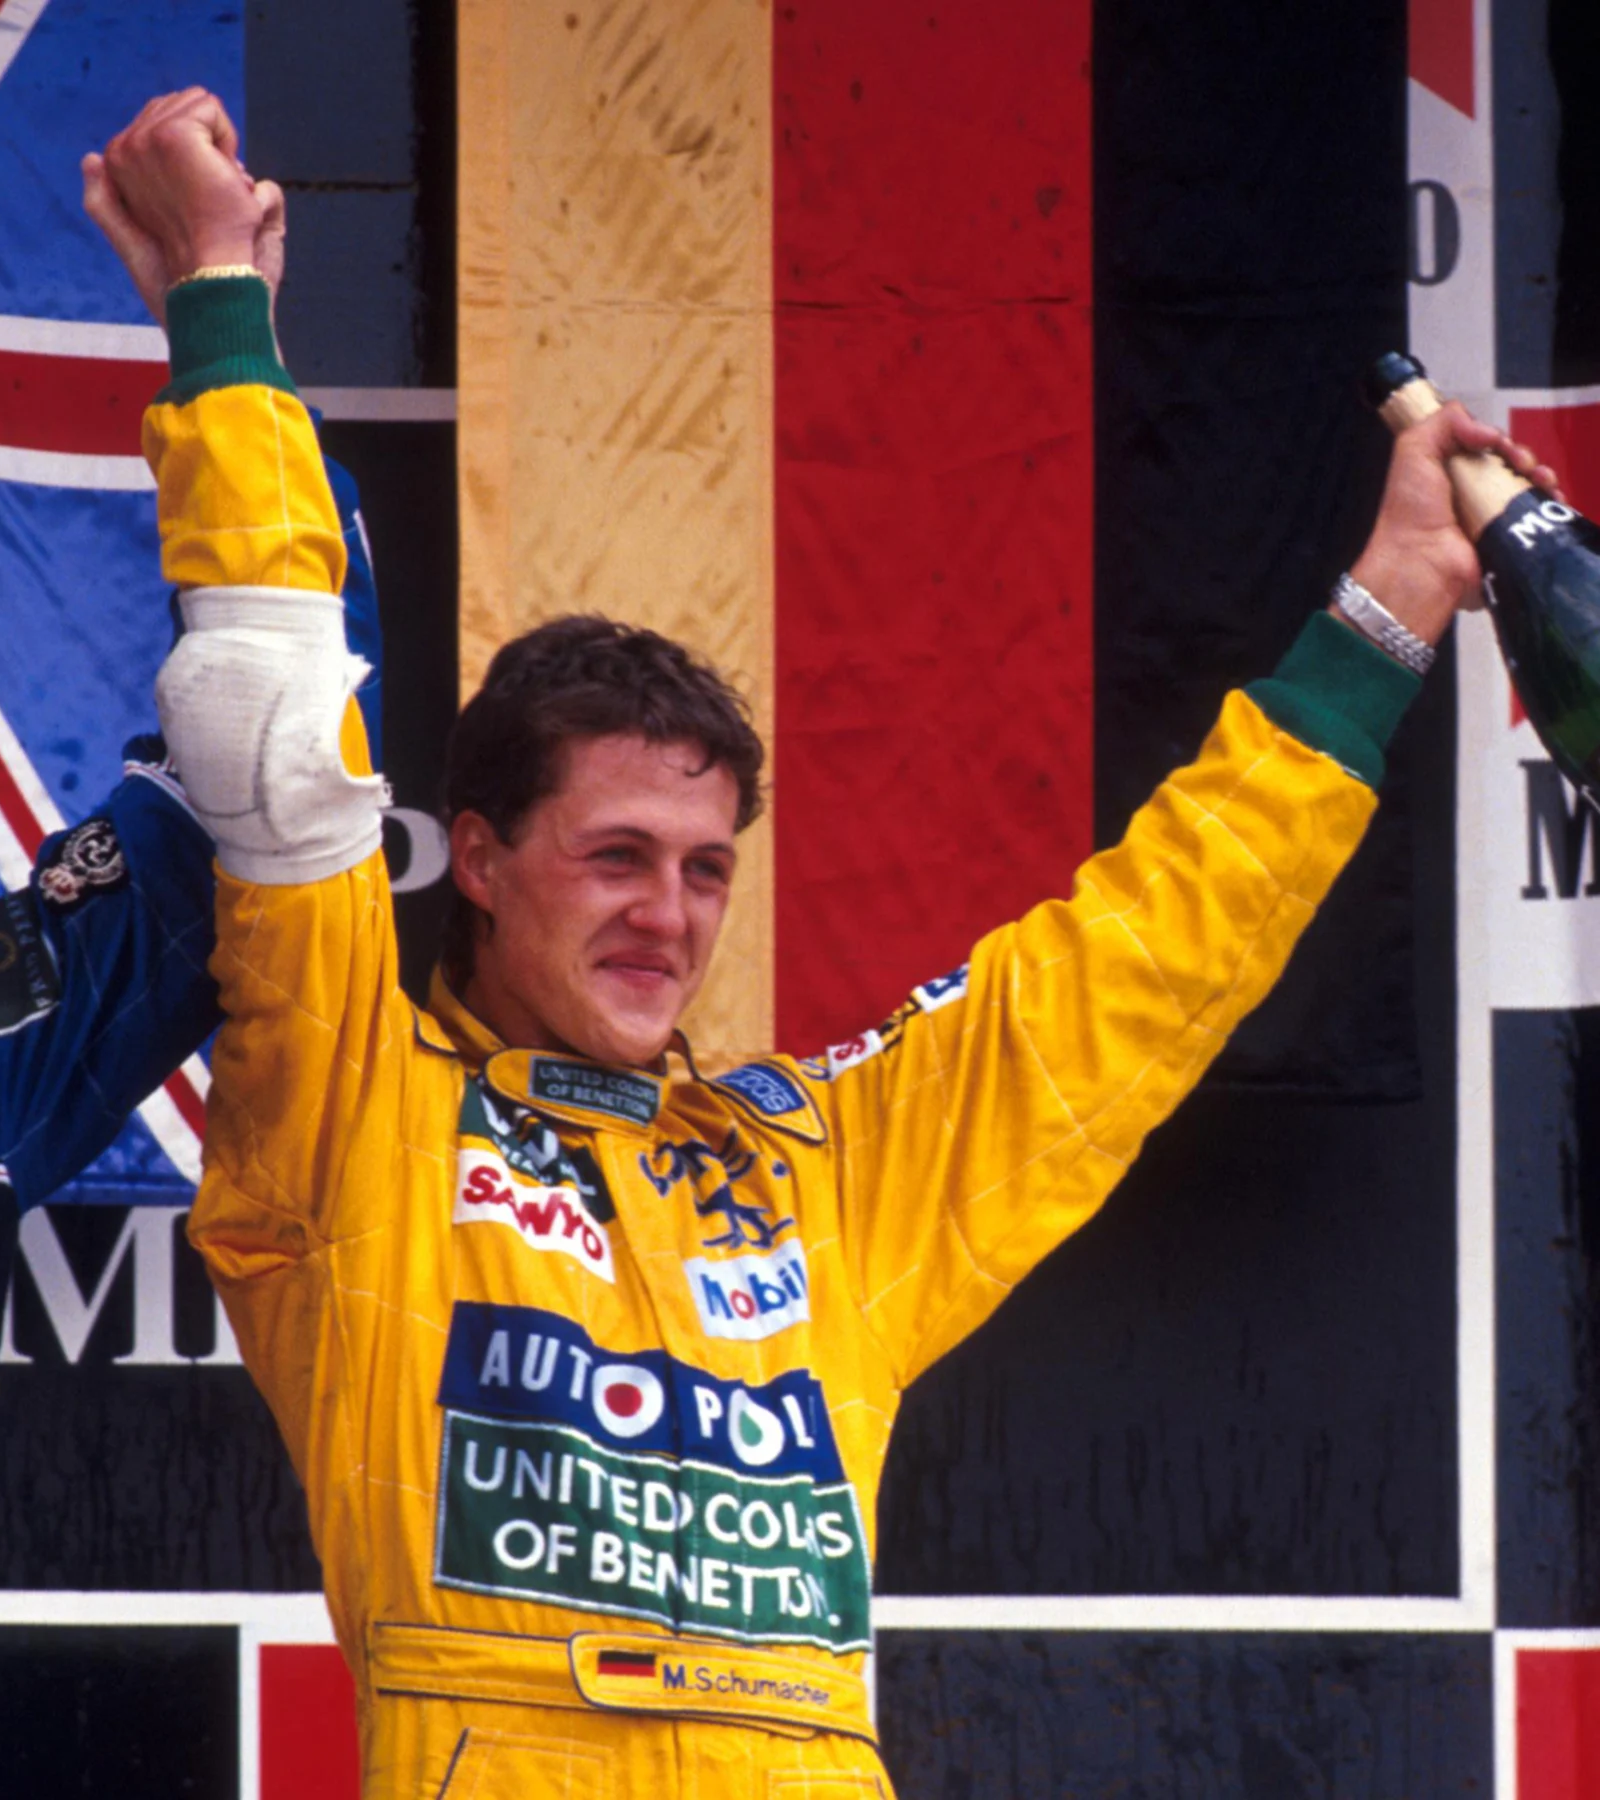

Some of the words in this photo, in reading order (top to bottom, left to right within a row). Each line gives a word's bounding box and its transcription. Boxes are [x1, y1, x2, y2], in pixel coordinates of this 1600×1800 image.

[546, 1083, 571, 1097] OF
[463, 1440, 694, 1533] UNITED
[493, 1518, 578, 1575] OF
